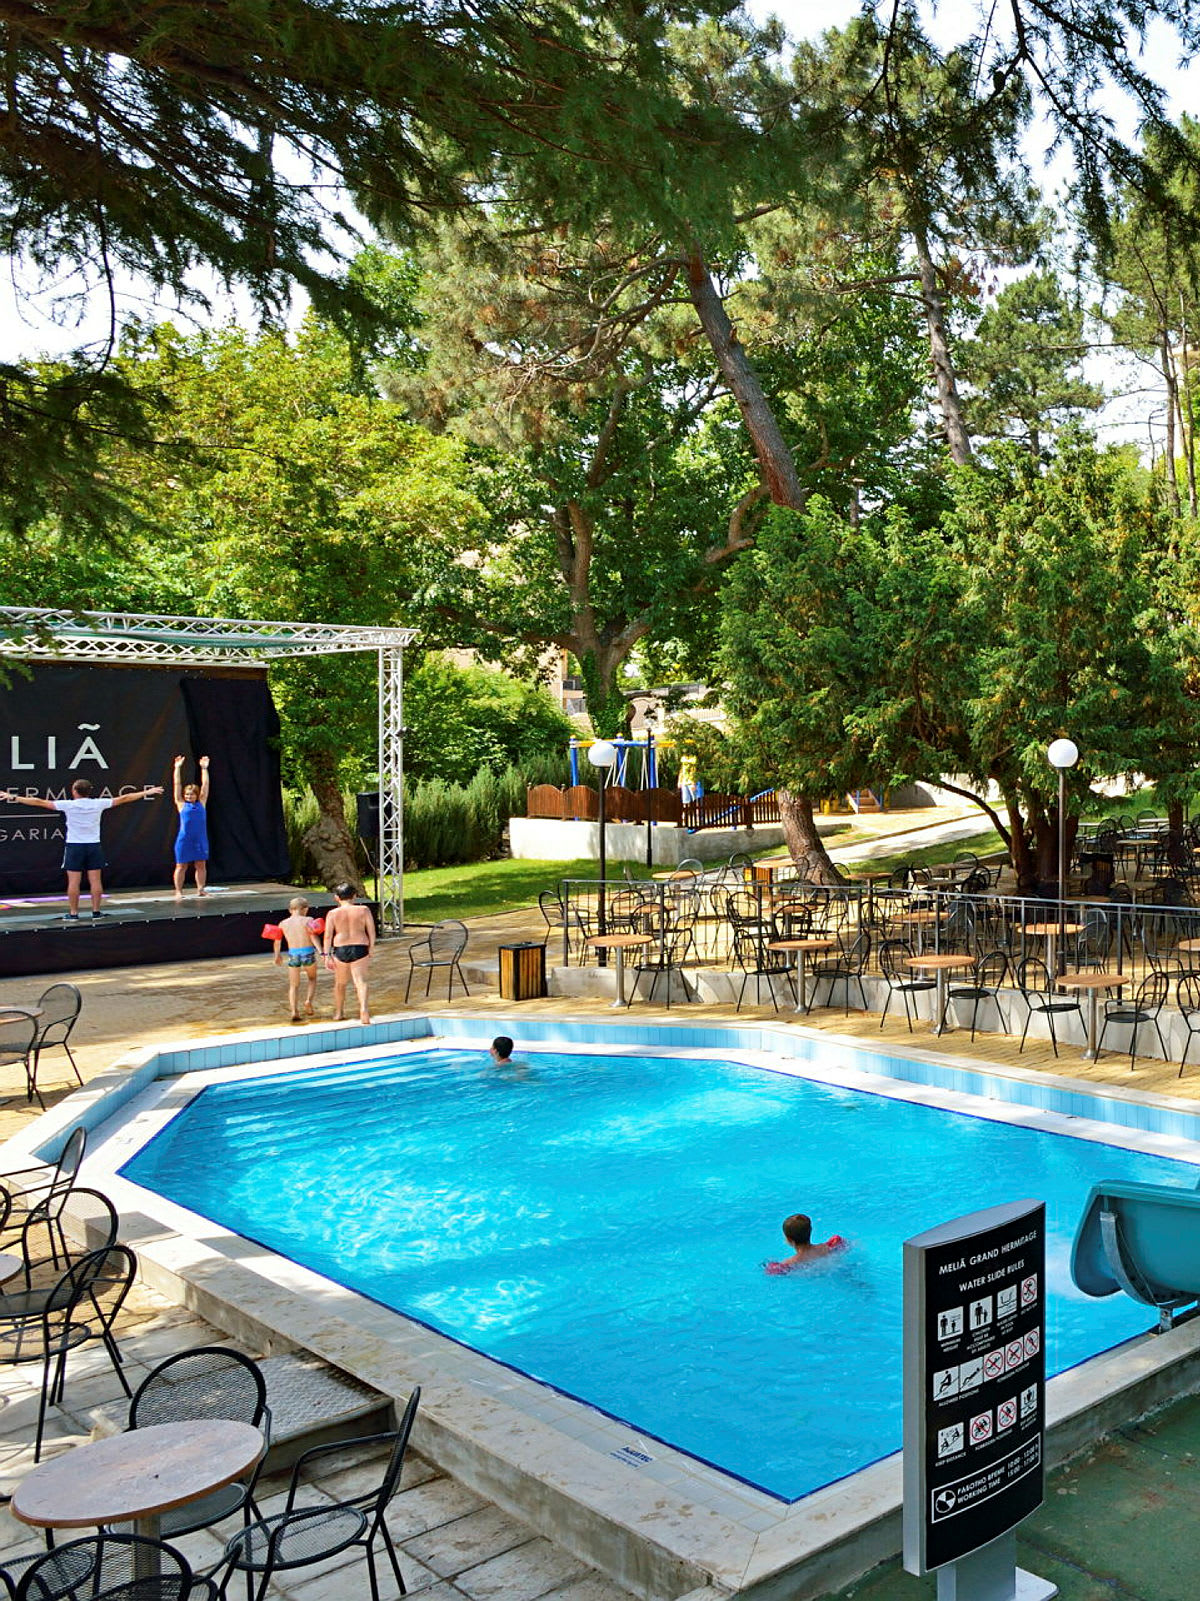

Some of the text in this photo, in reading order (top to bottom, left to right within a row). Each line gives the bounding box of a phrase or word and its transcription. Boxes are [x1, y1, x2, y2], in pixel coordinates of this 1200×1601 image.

[969, 1248, 999, 1266] GRAND
[1001, 1230, 1038, 1254] HERMITAGE
[959, 1258, 1025, 1292] WATER SLIDE RULES
[957, 1485, 987, 1504] WORKING
[988, 1477, 1001, 1489] TIME
